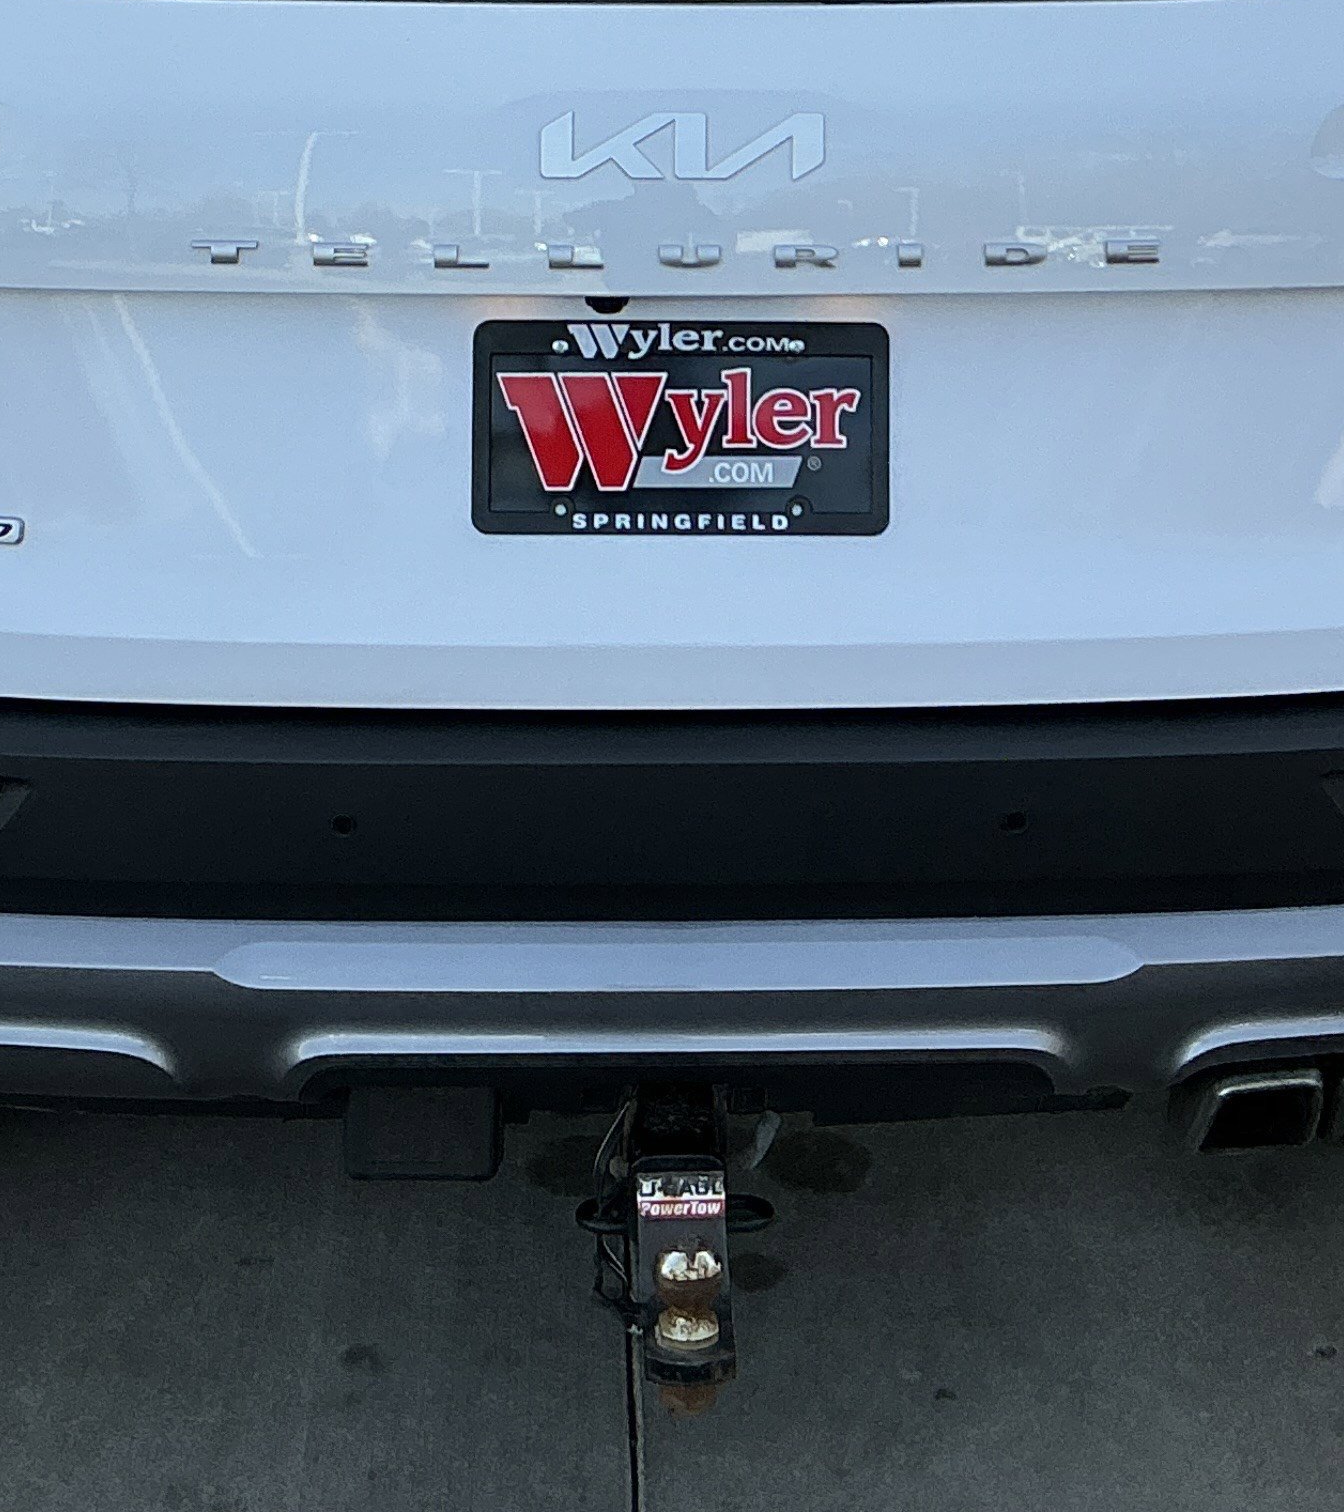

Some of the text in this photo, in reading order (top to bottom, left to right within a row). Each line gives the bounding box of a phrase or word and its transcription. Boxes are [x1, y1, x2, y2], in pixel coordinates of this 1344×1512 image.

[191, 239, 1160, 268] TELLURIDE
[497, 368, 860, 490] Wyler
[709, 463, 773, 484] .COM
[572, 513, 789, 530] SPRINGFIELD
